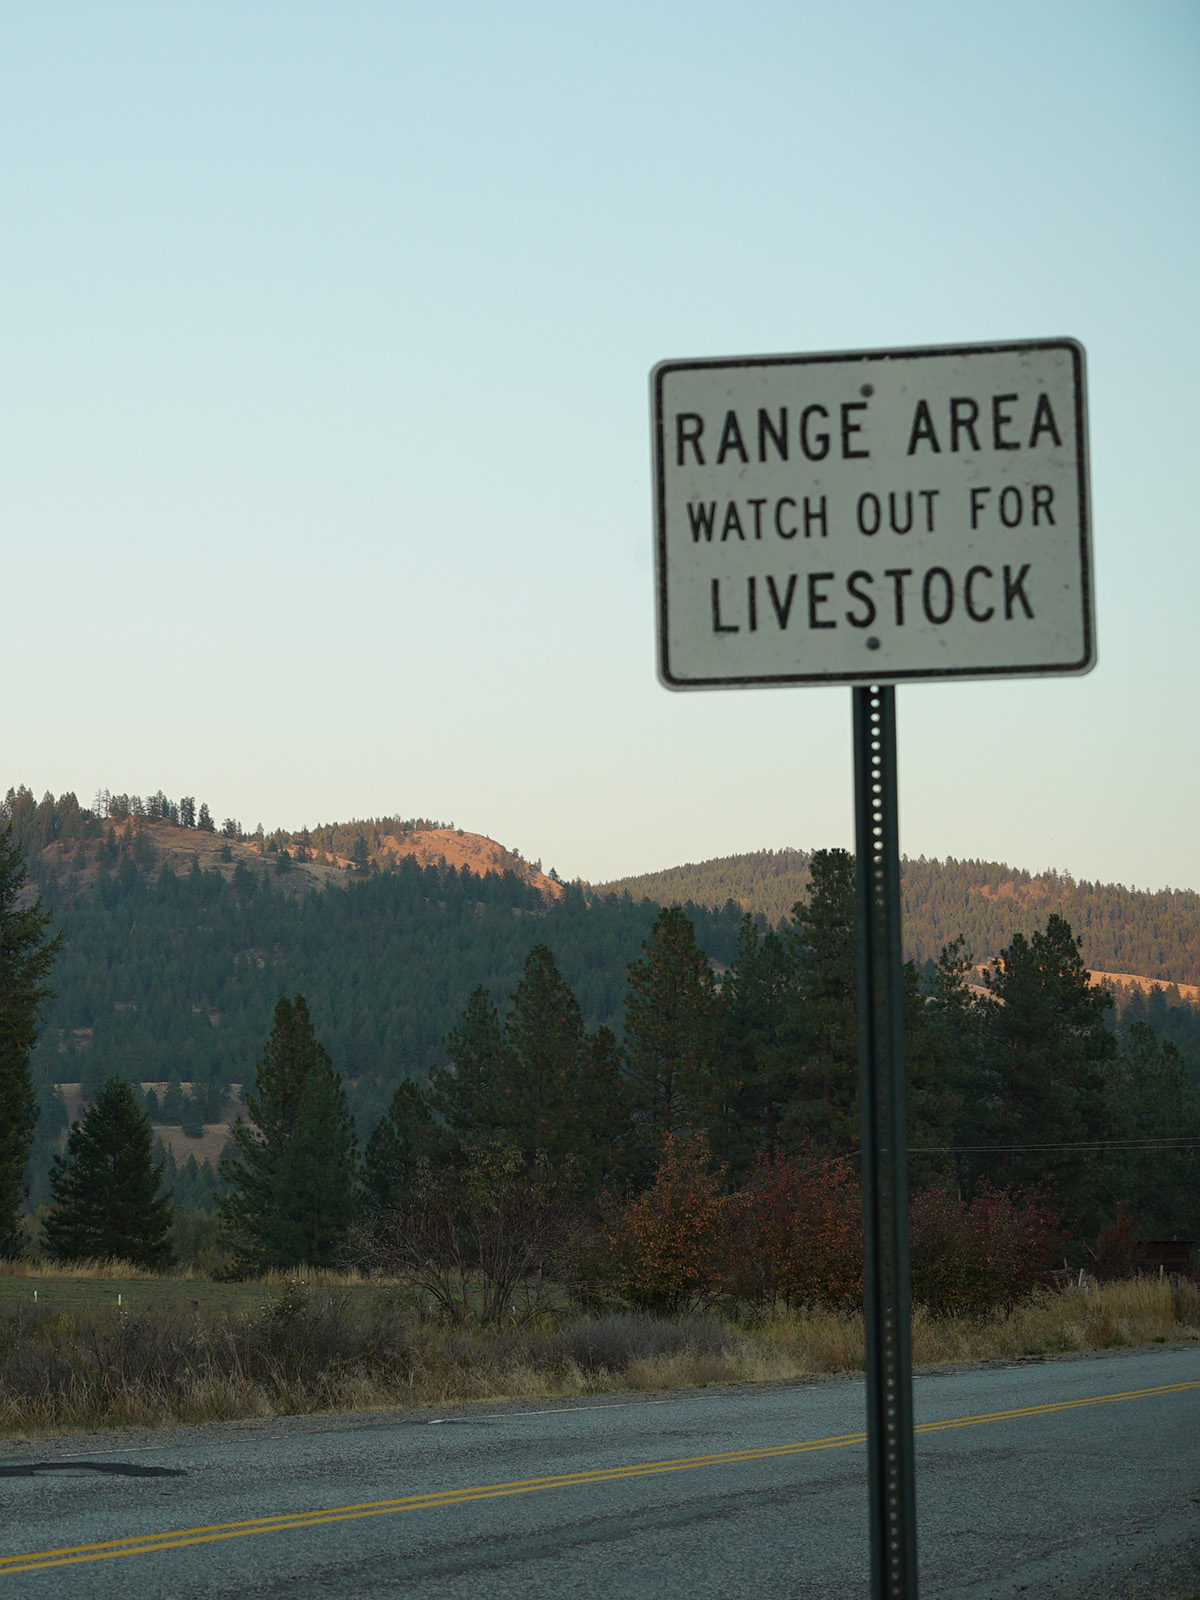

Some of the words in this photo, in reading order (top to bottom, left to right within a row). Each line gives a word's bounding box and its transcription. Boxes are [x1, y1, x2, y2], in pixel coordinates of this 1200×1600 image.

[674, 402, 870, 466] RANGE
[906, 392, 1063, 456] AREA
[686, 495, 829, 543] WATCH
[856, 489, 941, 537] OUT
[969, 484, 1057, 530] FOR
[710, 563, 1035, 633] LIVESTOCK
